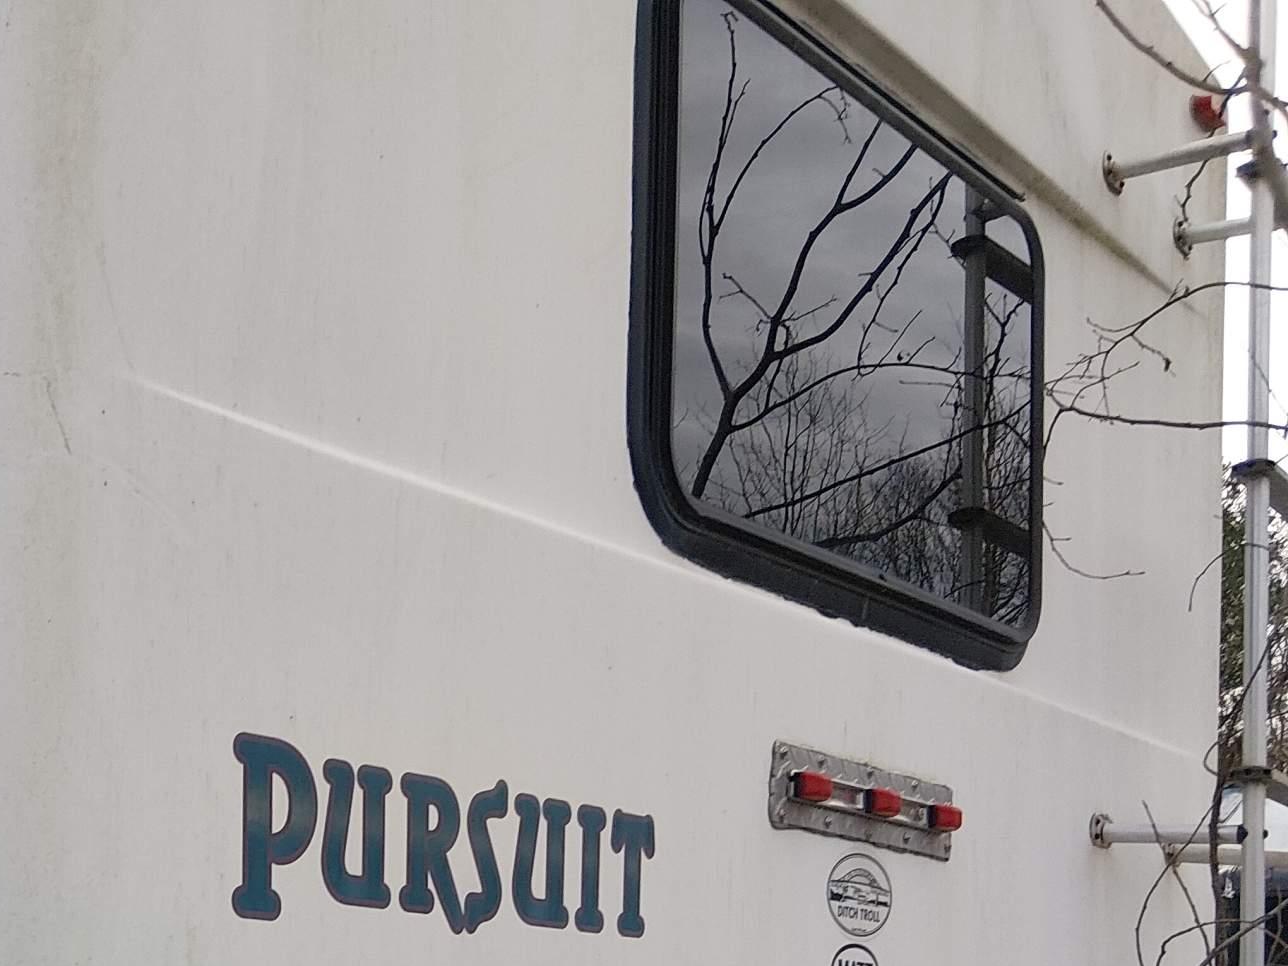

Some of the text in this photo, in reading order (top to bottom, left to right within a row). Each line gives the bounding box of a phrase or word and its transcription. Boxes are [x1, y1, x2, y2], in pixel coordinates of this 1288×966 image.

[232, 732, 655, 938] PURSUIT
[837, 905, 881, 923] DITCH TROLL
